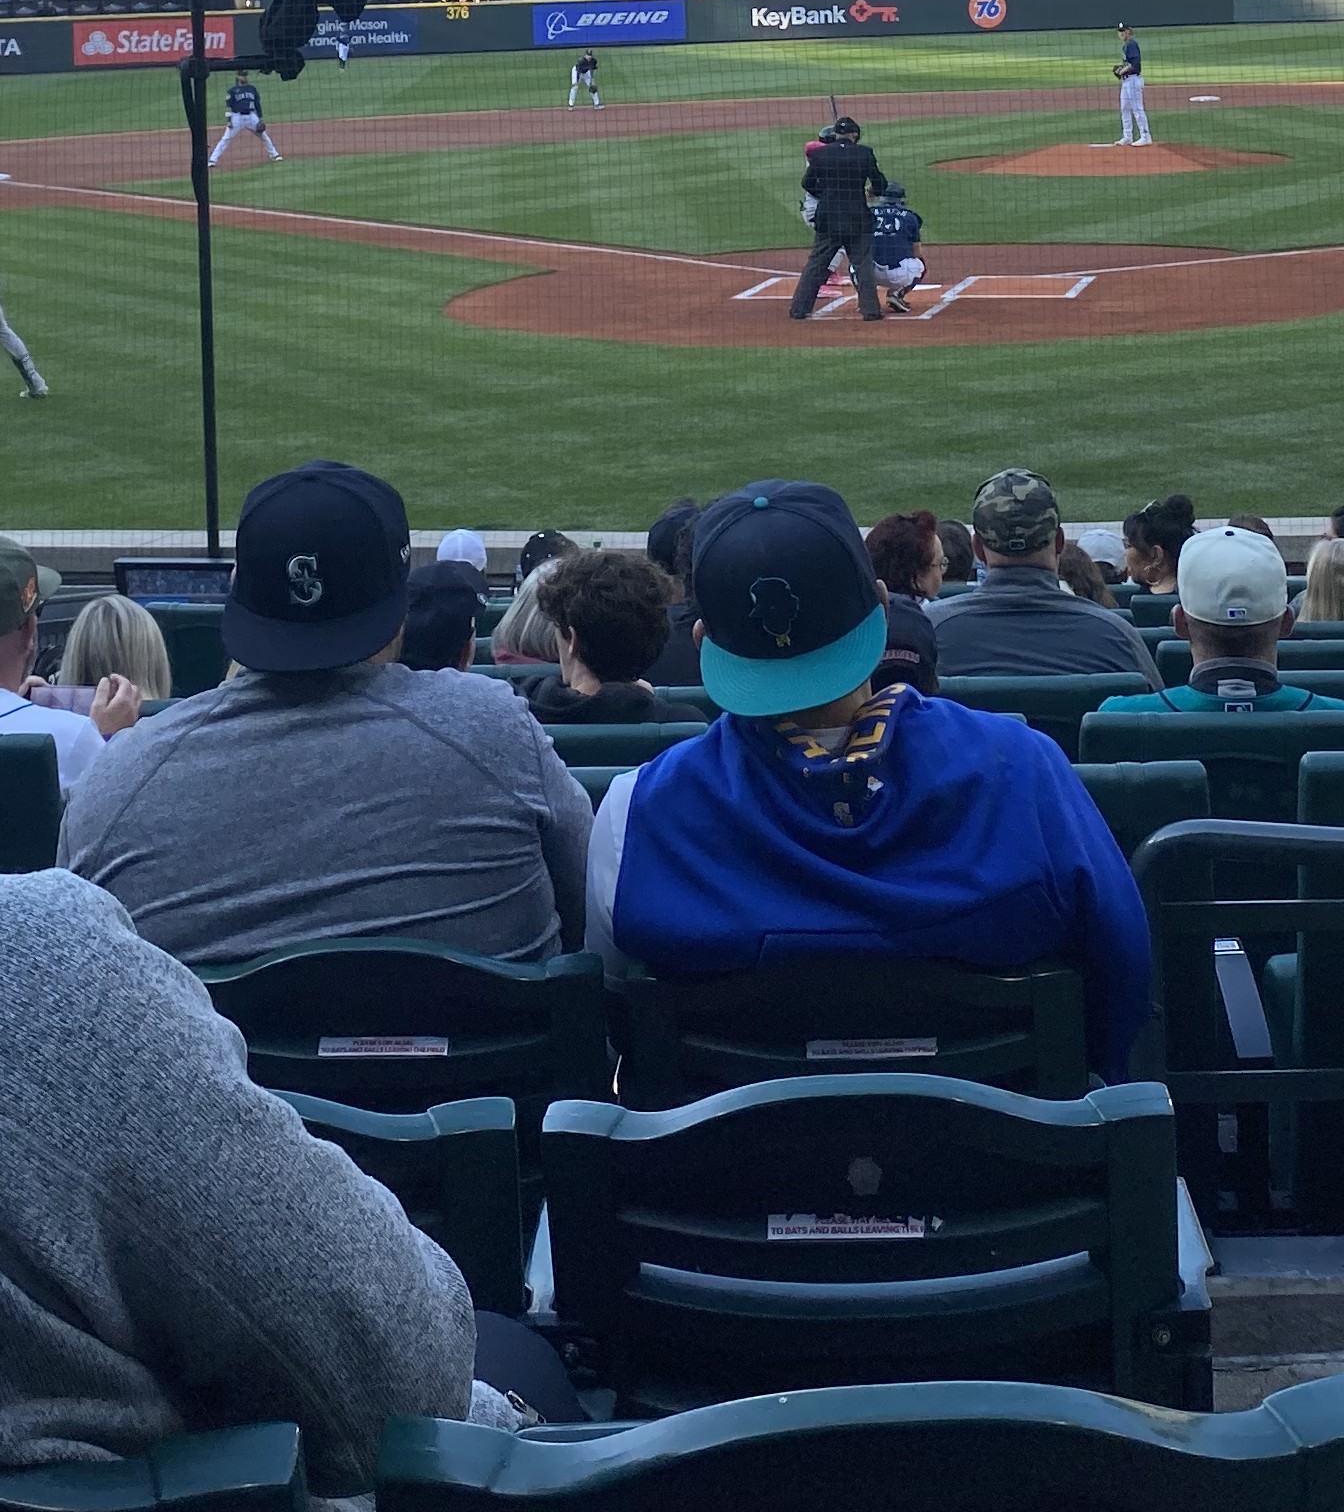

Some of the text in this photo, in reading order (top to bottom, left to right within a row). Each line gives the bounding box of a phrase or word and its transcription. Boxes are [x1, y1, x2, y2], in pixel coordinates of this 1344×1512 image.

[446, 6, 470, 19] 376
[973, 0, 1000, 18] 76
[577, 9, 669, 26] BOEING
[752, 4, 847, 30] KeyBank
[349, 19, 387, 31] Mason
[368, 32, 409, 44] Health
[287, 552, 323, 606] S
[771, 1226, 784, 1235] TO
[785, 1226, 807, 1235] BATS
[809, 1226, 829, 1235] AND
[830, 1225, 859, 1235] BALLS
[860, 1225, 899, 1234] LEAVING
